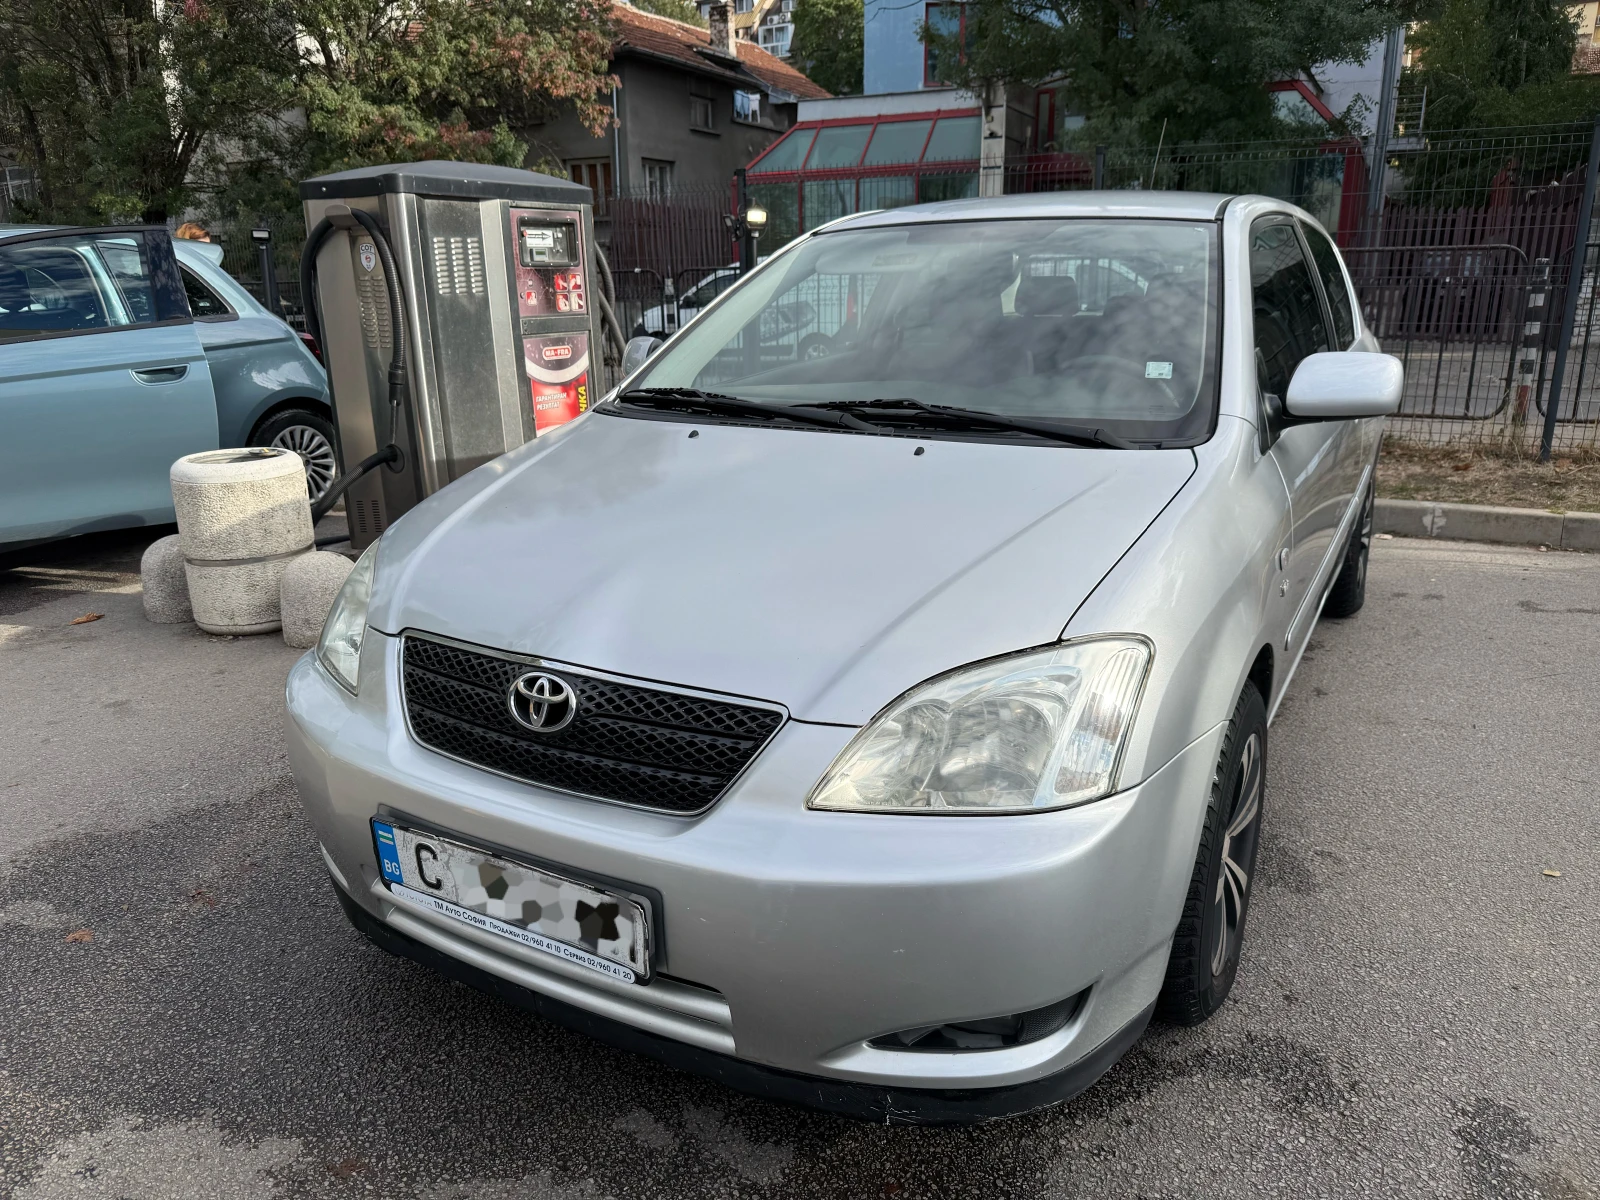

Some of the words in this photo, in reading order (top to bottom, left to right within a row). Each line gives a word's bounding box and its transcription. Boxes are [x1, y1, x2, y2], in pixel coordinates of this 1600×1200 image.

[536, 392, 567, 402] ГАРАНТИРАН
[383, 858, 400, 876] BG
[521, 933, 544, 947] 02/960
[587, 957, 611, 973] 02/960
[612, 967, 620, 976] 41
[622, 971, 632, 980] 20
